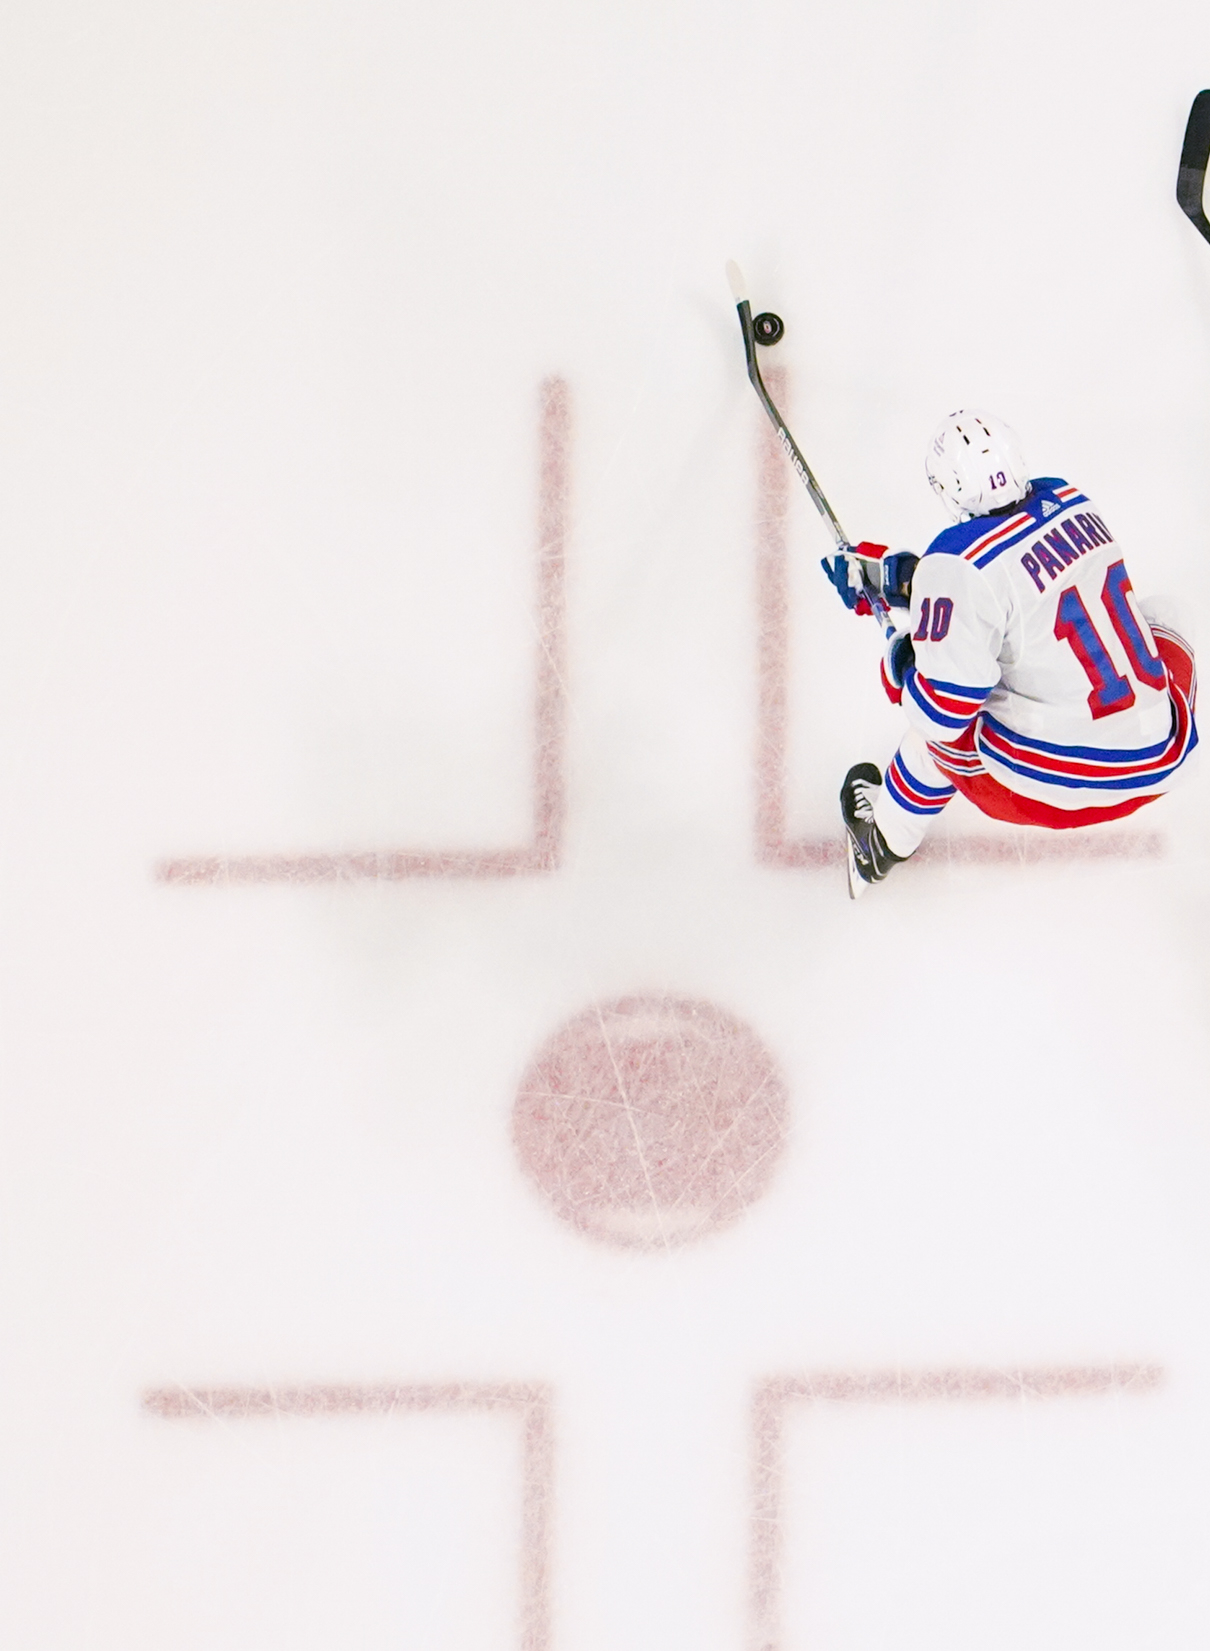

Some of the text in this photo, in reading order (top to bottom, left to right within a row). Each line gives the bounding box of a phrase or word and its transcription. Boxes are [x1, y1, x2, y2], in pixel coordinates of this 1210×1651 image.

[988, 471, 1007, 490] 10
[913, 597, 954, 642] 10
[1054, 558, 1167, 721] 10
